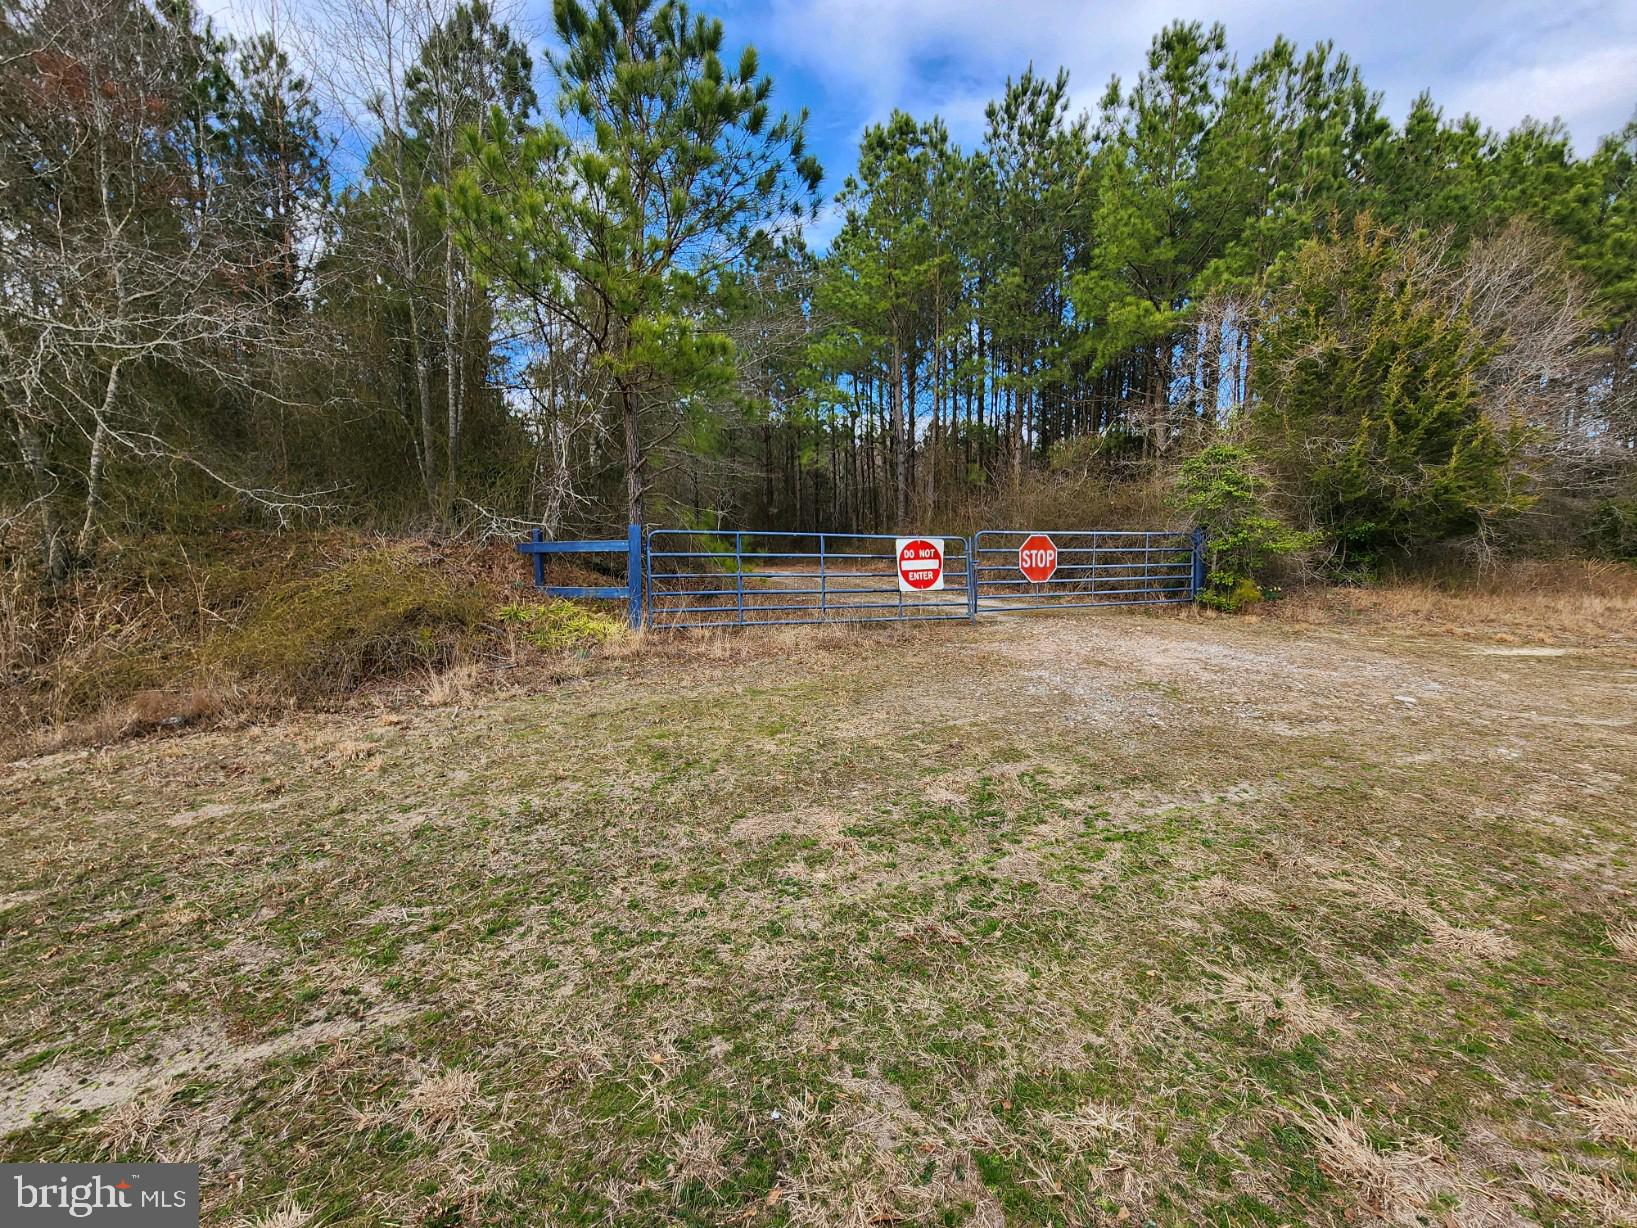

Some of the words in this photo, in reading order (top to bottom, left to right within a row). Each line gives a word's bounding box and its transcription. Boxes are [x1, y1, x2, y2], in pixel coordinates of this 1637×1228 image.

[904, 549, 914, 559] DO
[919, 549, 935, 558] NOT
[1022, 549, 1055, 568] STOP
[909, 571, 933, 581] ENTER
